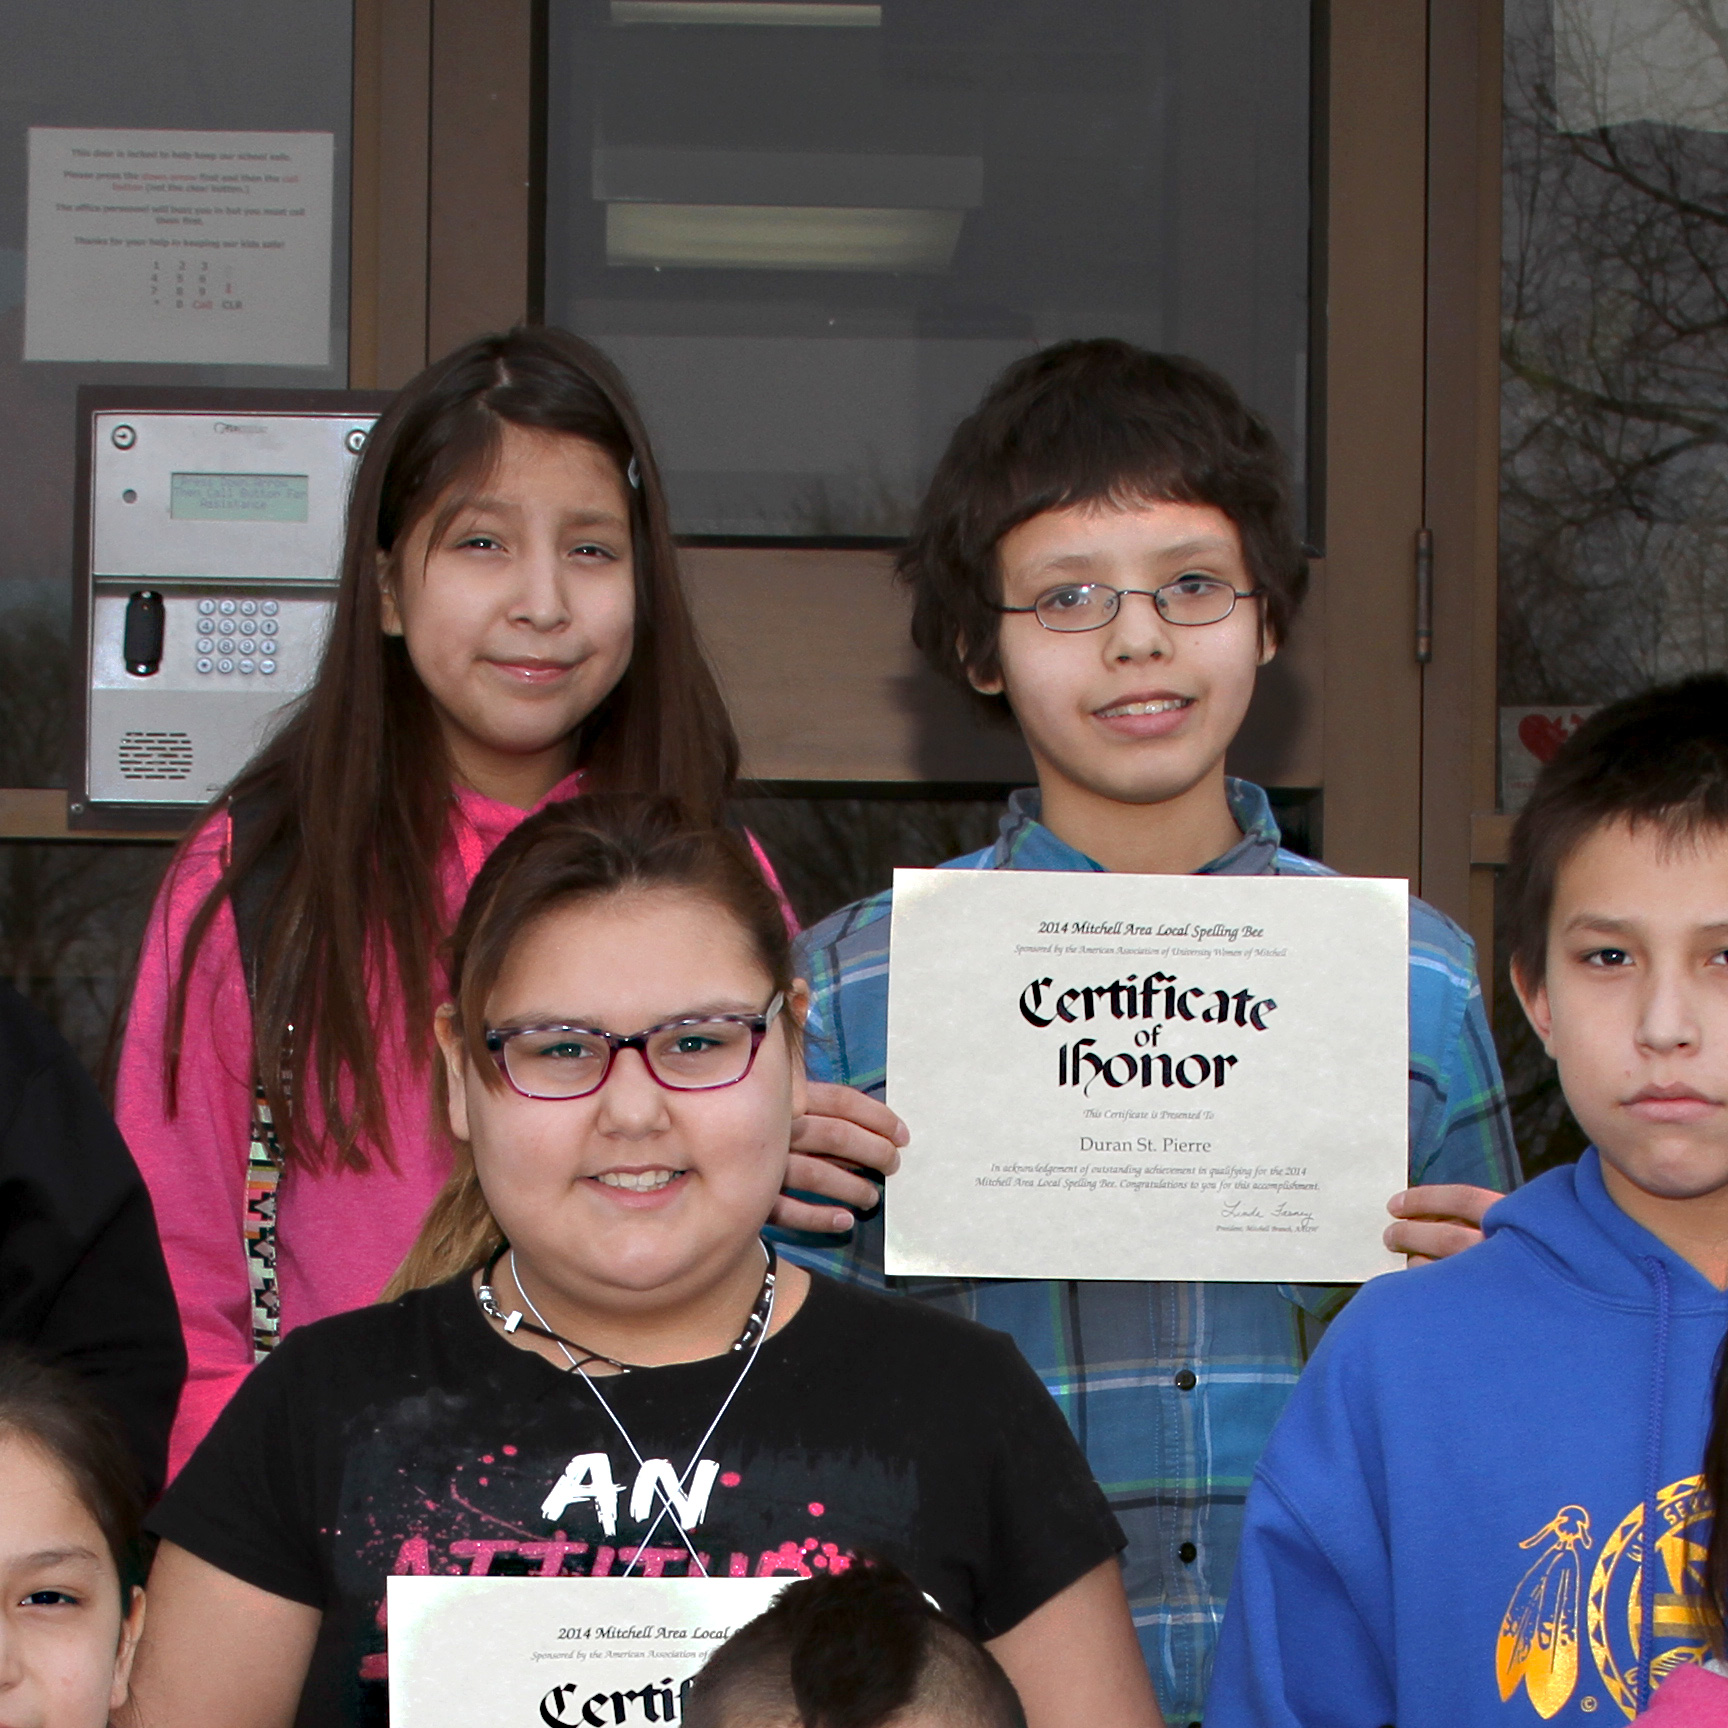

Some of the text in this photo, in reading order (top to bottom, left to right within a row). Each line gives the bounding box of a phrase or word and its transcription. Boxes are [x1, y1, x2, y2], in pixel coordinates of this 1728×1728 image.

[207, 488, 233, 498] Call
[240, 488, 281, 498] Button
[200, 498, 267, 509] Assistance
[1038, 921, 1264, 942] 2014 Mitchell Area Local Spelling Bee
[1019, 971, 1278, 1033] Certificate
[1134, 1023, 1163, 1048] of
[1058, 1037, 1239, 1098] Honor
[1083, 1108, 1214, 1123] This Certificate is Presented To
[1080, 1137, 1211, 1153] Duran St. Pierre
[541, 1453, 720, 1536] AN
[557, 1625, 730, 1640] 2014 Mitchell Area Local
